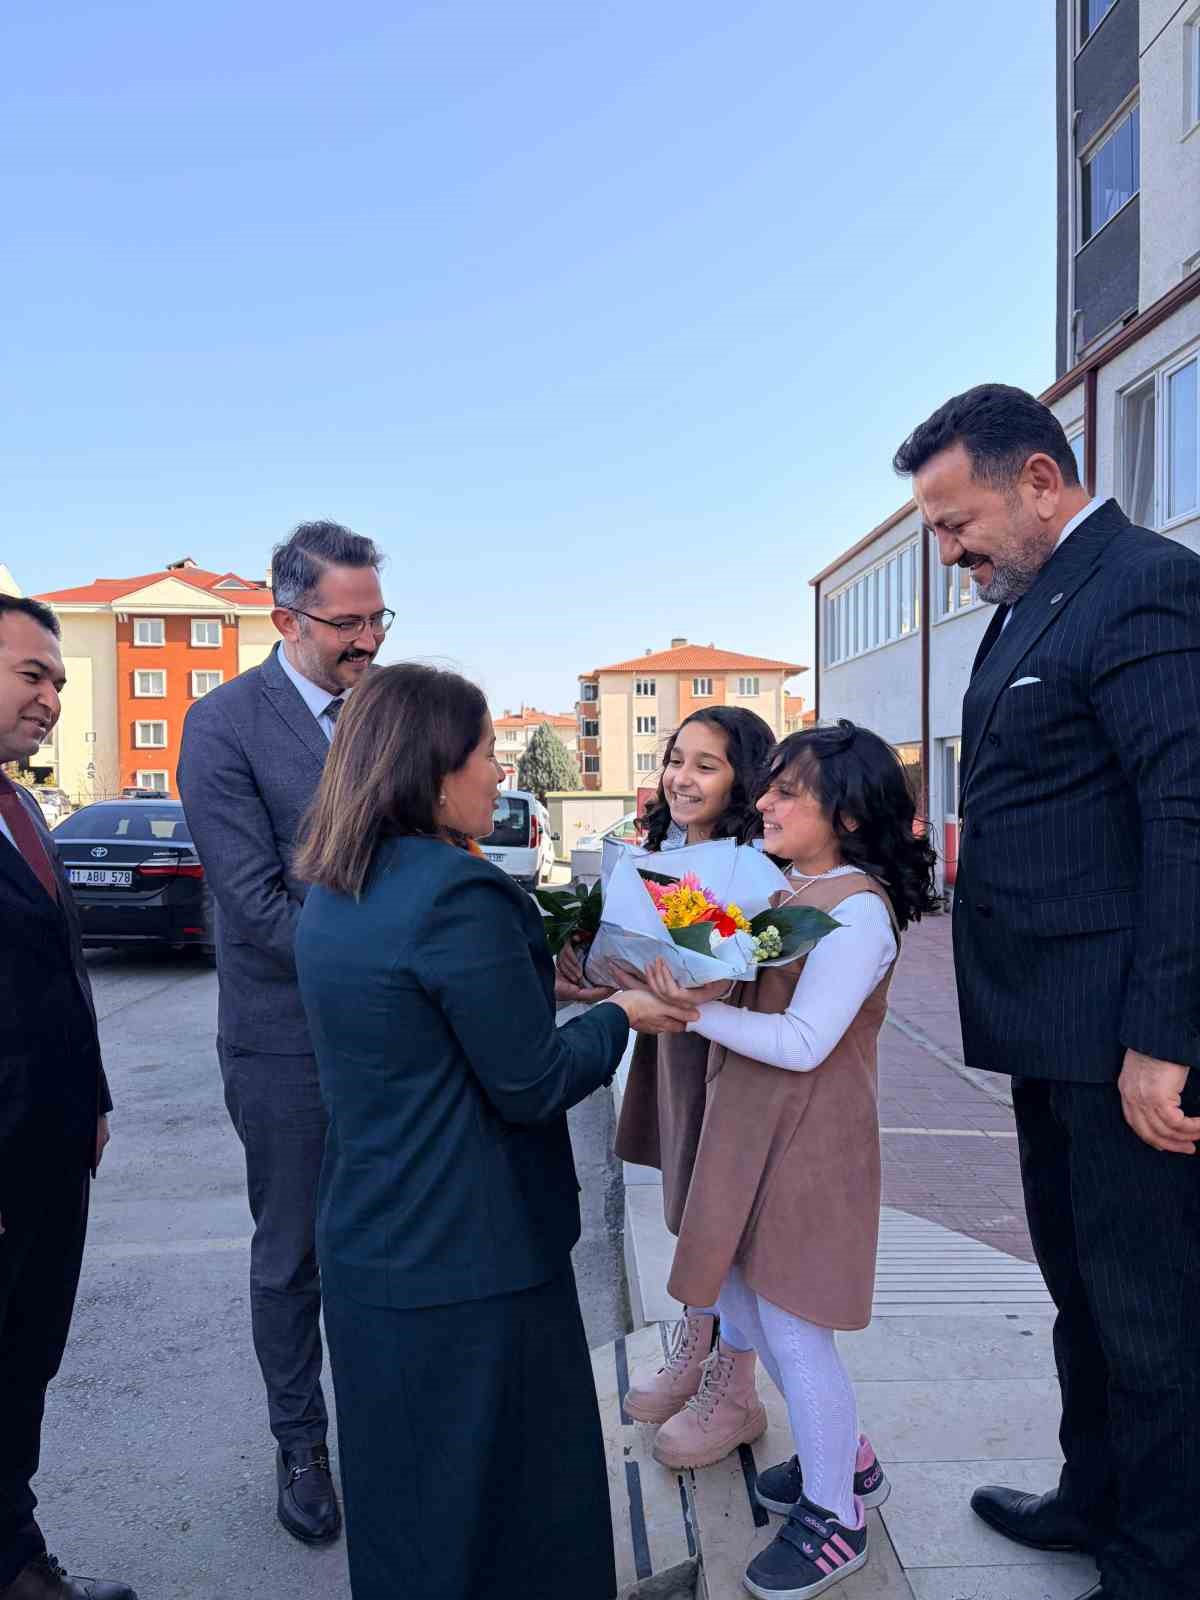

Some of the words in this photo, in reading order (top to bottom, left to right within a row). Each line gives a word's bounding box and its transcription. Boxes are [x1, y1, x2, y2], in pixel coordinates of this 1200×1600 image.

[71, 871, 80, 881] 11
[87, 871, 106, 882] ABU
[111, 872, 130, 883] 578
